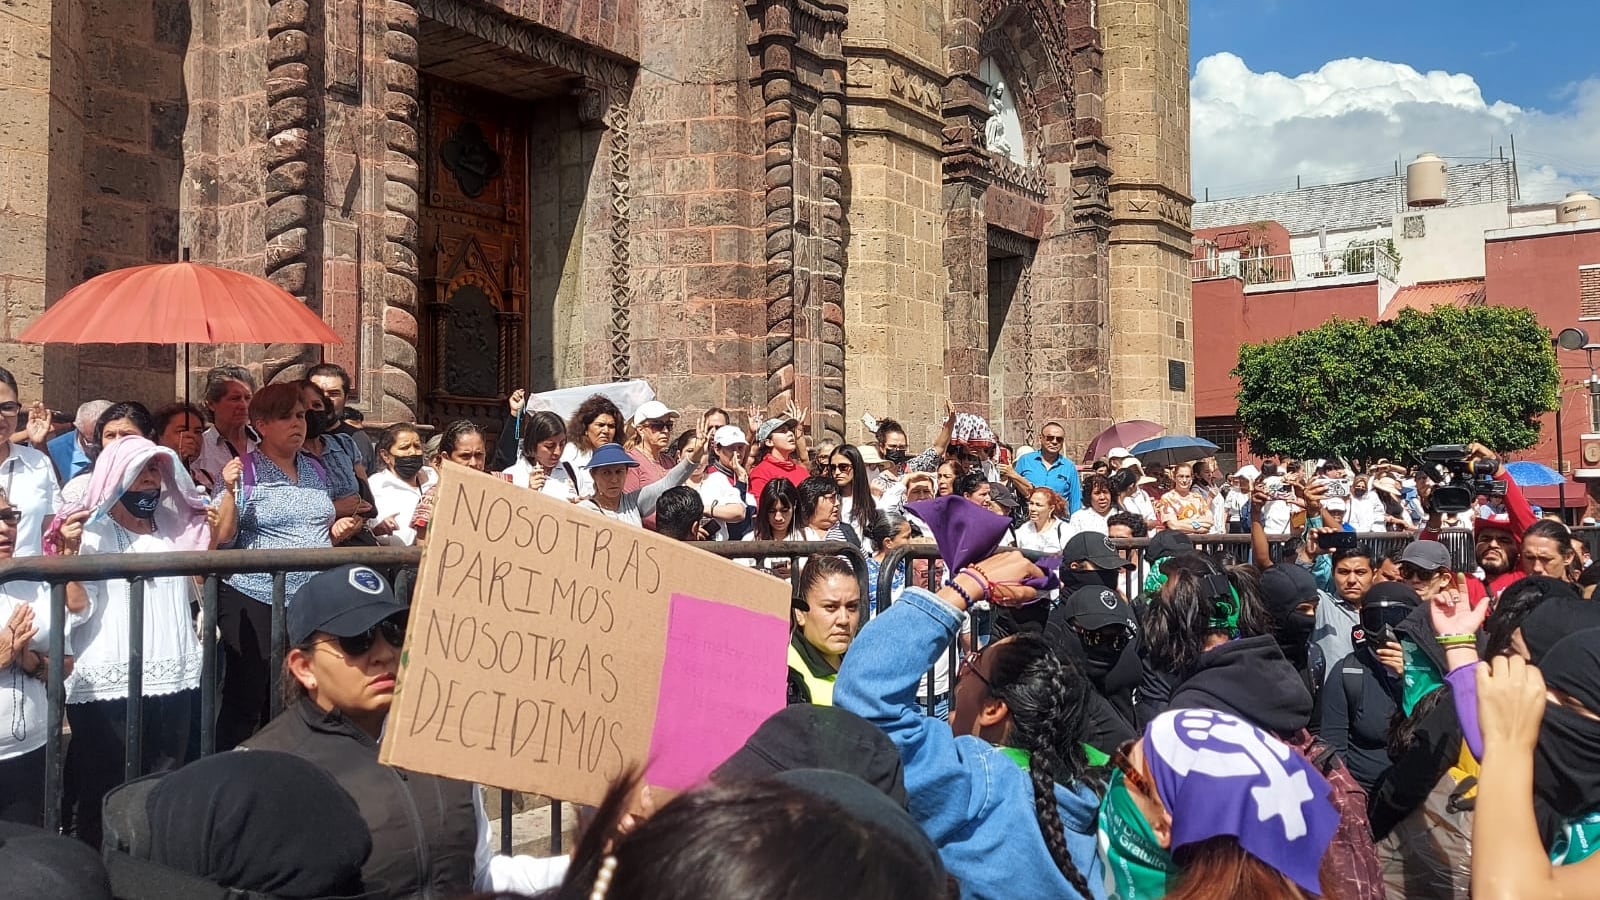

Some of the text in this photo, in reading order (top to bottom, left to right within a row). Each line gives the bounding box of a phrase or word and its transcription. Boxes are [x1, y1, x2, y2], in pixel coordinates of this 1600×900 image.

[436, 539, 615, 633] PARIMOS
[452, 483, 661, 594] NOSOTRAS
[424, 609, 619, 703] NOSOTRAS
[409, 668, 623, 782] DECIDIMOS
